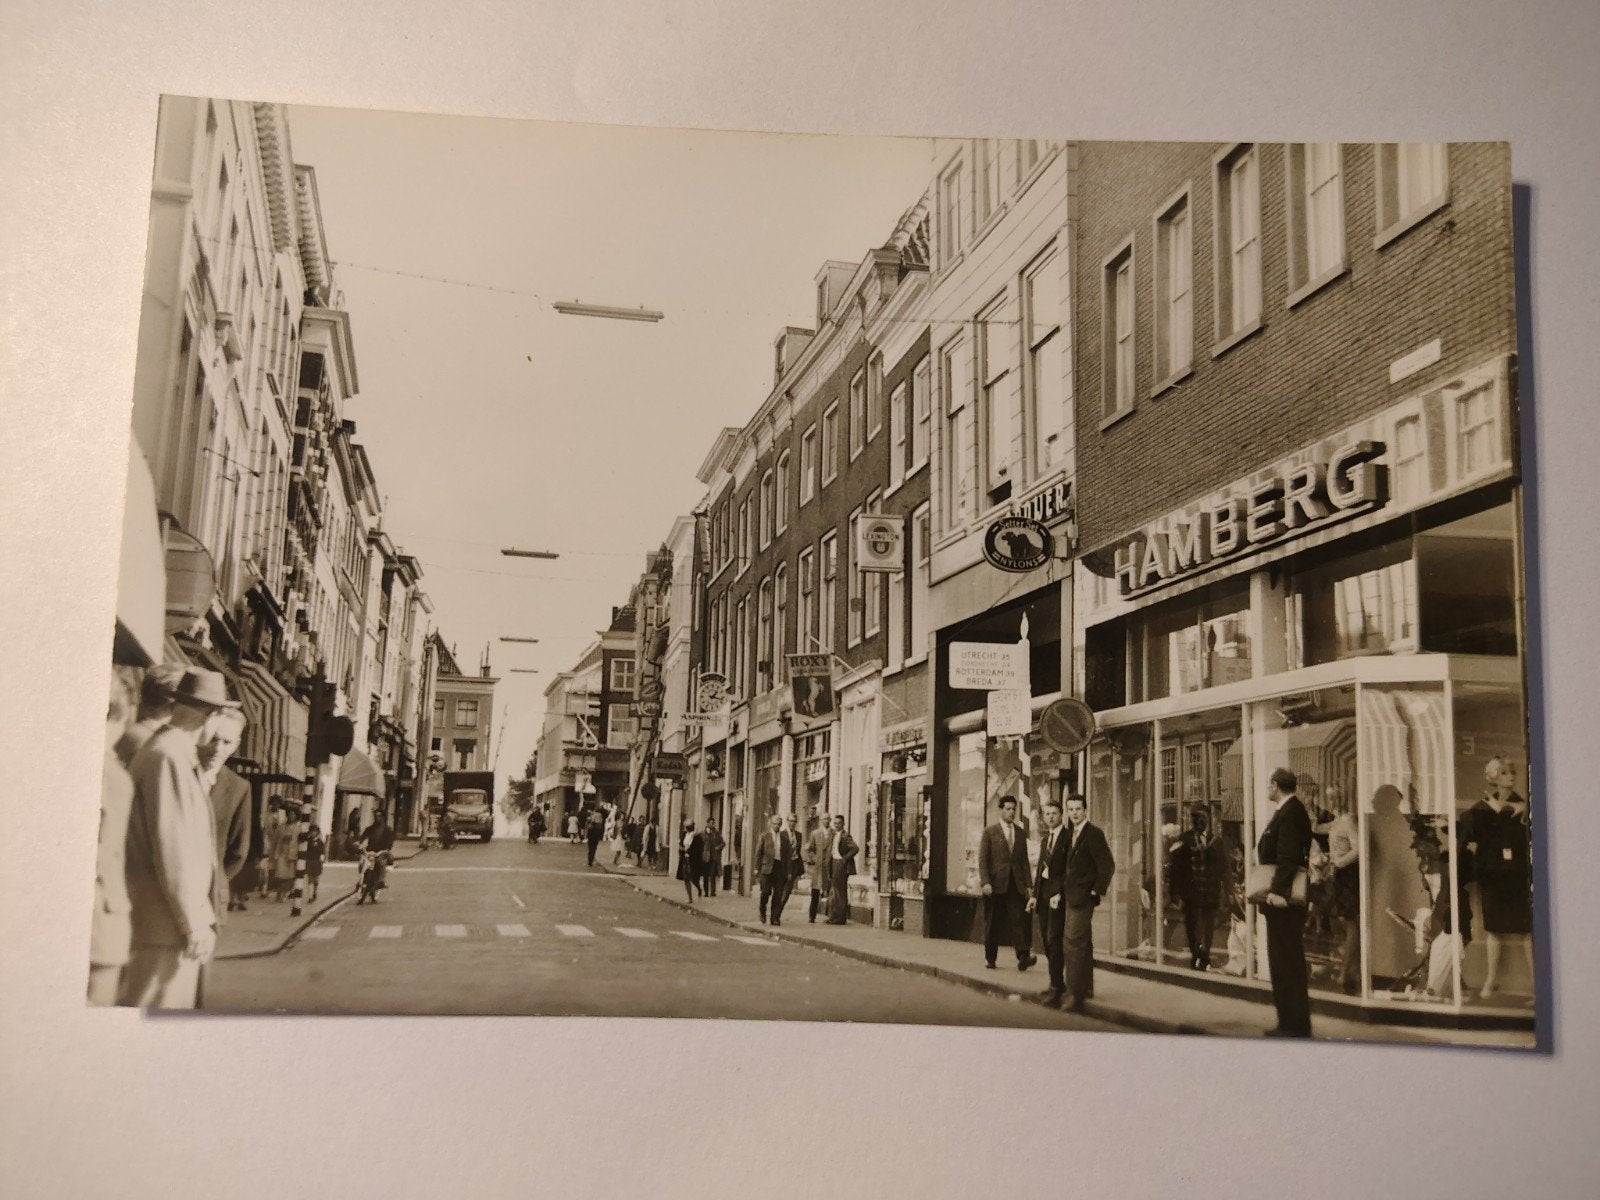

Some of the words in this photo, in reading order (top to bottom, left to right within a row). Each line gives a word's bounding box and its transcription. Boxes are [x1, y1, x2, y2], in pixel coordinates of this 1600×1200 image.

[1114, 440, 1389, 595] HAMBERG
[862, 532, 900, 541] LEXINGTON
[999, 556, 1039, 568] NYLONS
[961, 651, 997, 660] UTRECHT
[790, 655, 829, 667] ROXY
[955, 667, 1004, 677] ROTTERDAM
[966, 677, 993, 685] BREDA
